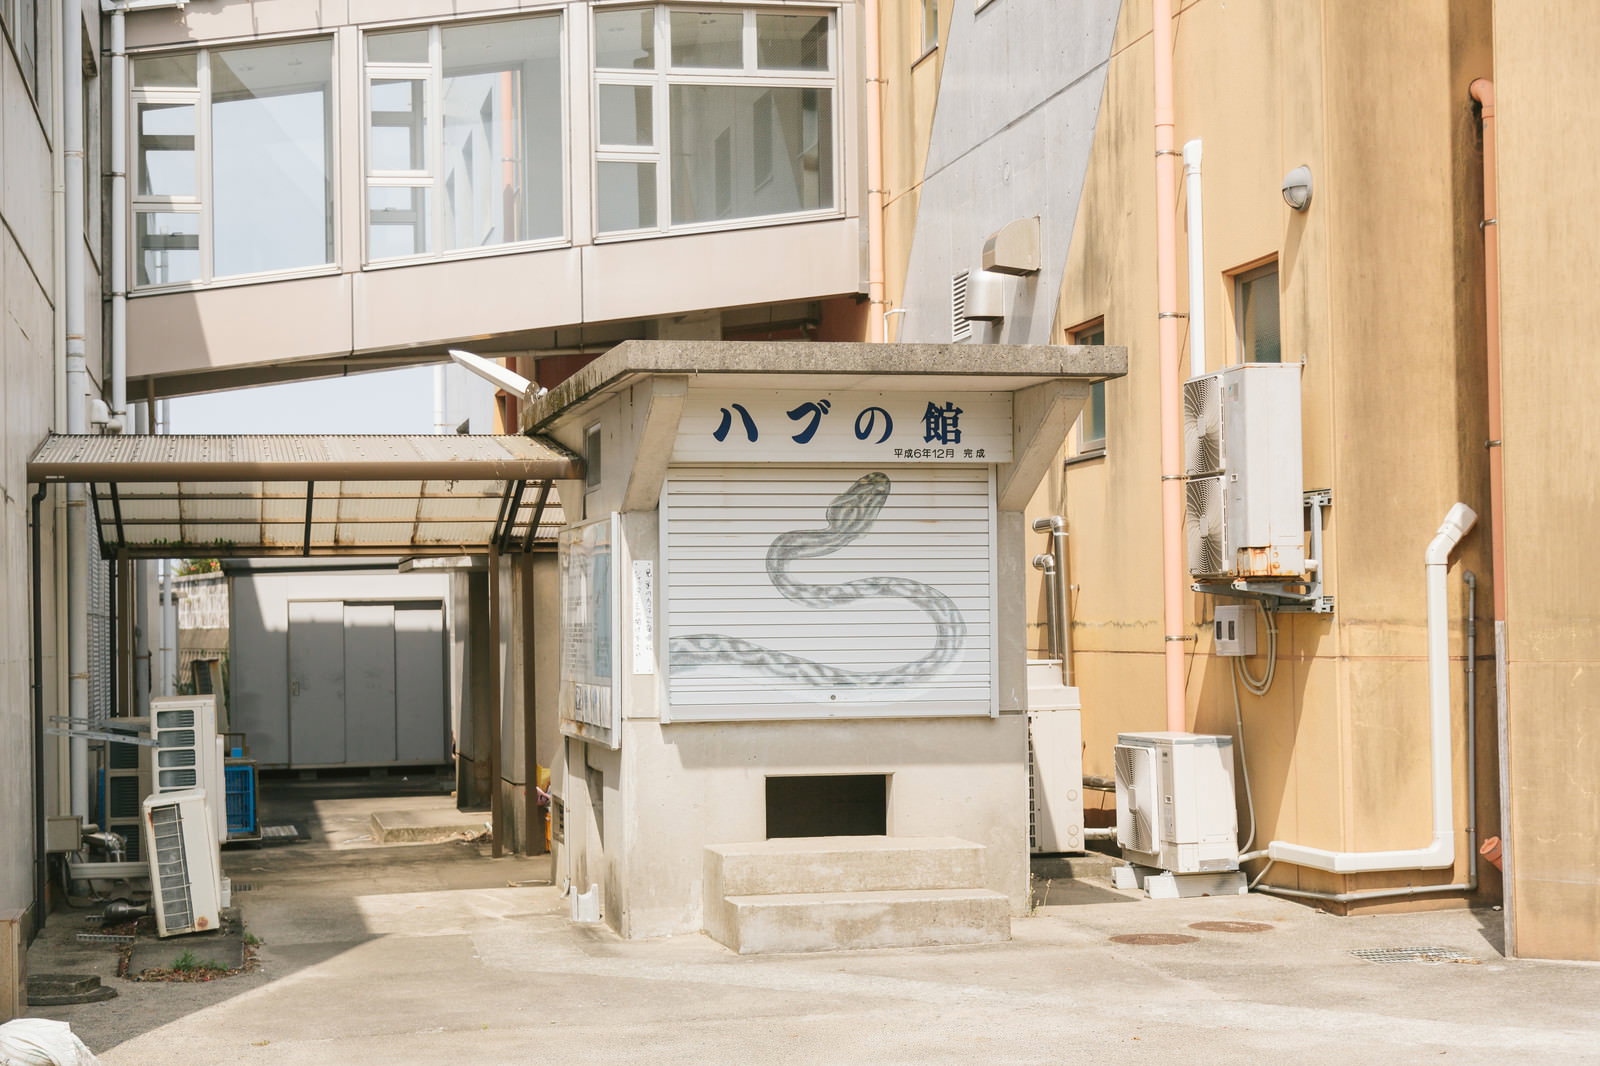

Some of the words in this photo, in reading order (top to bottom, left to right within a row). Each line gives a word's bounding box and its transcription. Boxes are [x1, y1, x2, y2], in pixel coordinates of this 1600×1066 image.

[713, 399, 963, 445] ハブの館
[894, 447, 954, 459] 平成6年12月
[963, 448, 986, 459] 完成
